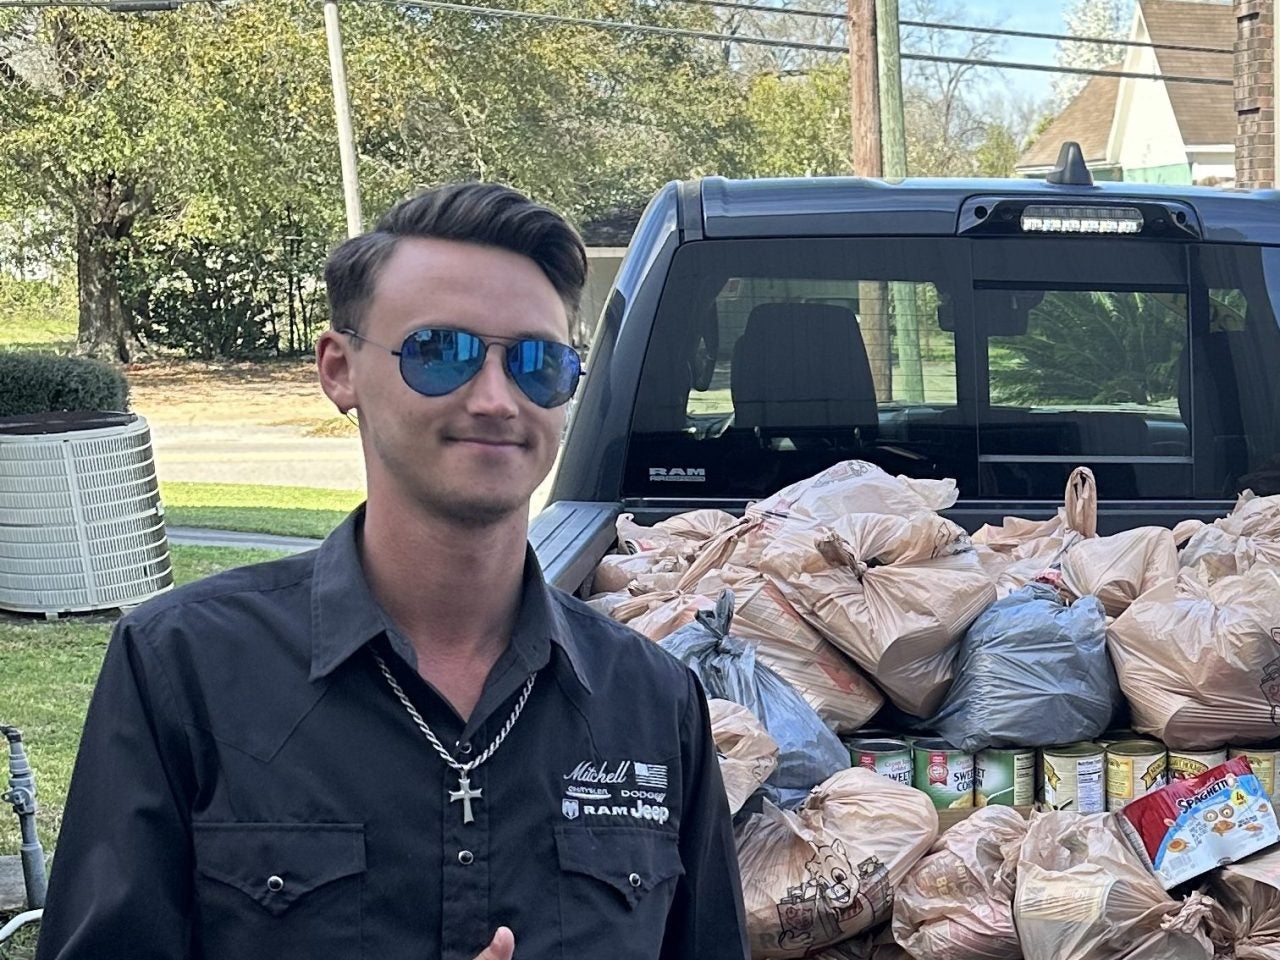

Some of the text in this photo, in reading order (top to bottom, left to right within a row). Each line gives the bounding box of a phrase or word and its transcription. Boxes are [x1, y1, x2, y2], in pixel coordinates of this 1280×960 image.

[563, 760, 631, 783] Mitchell
[583, 799, 670, 825] RAM Jeep
